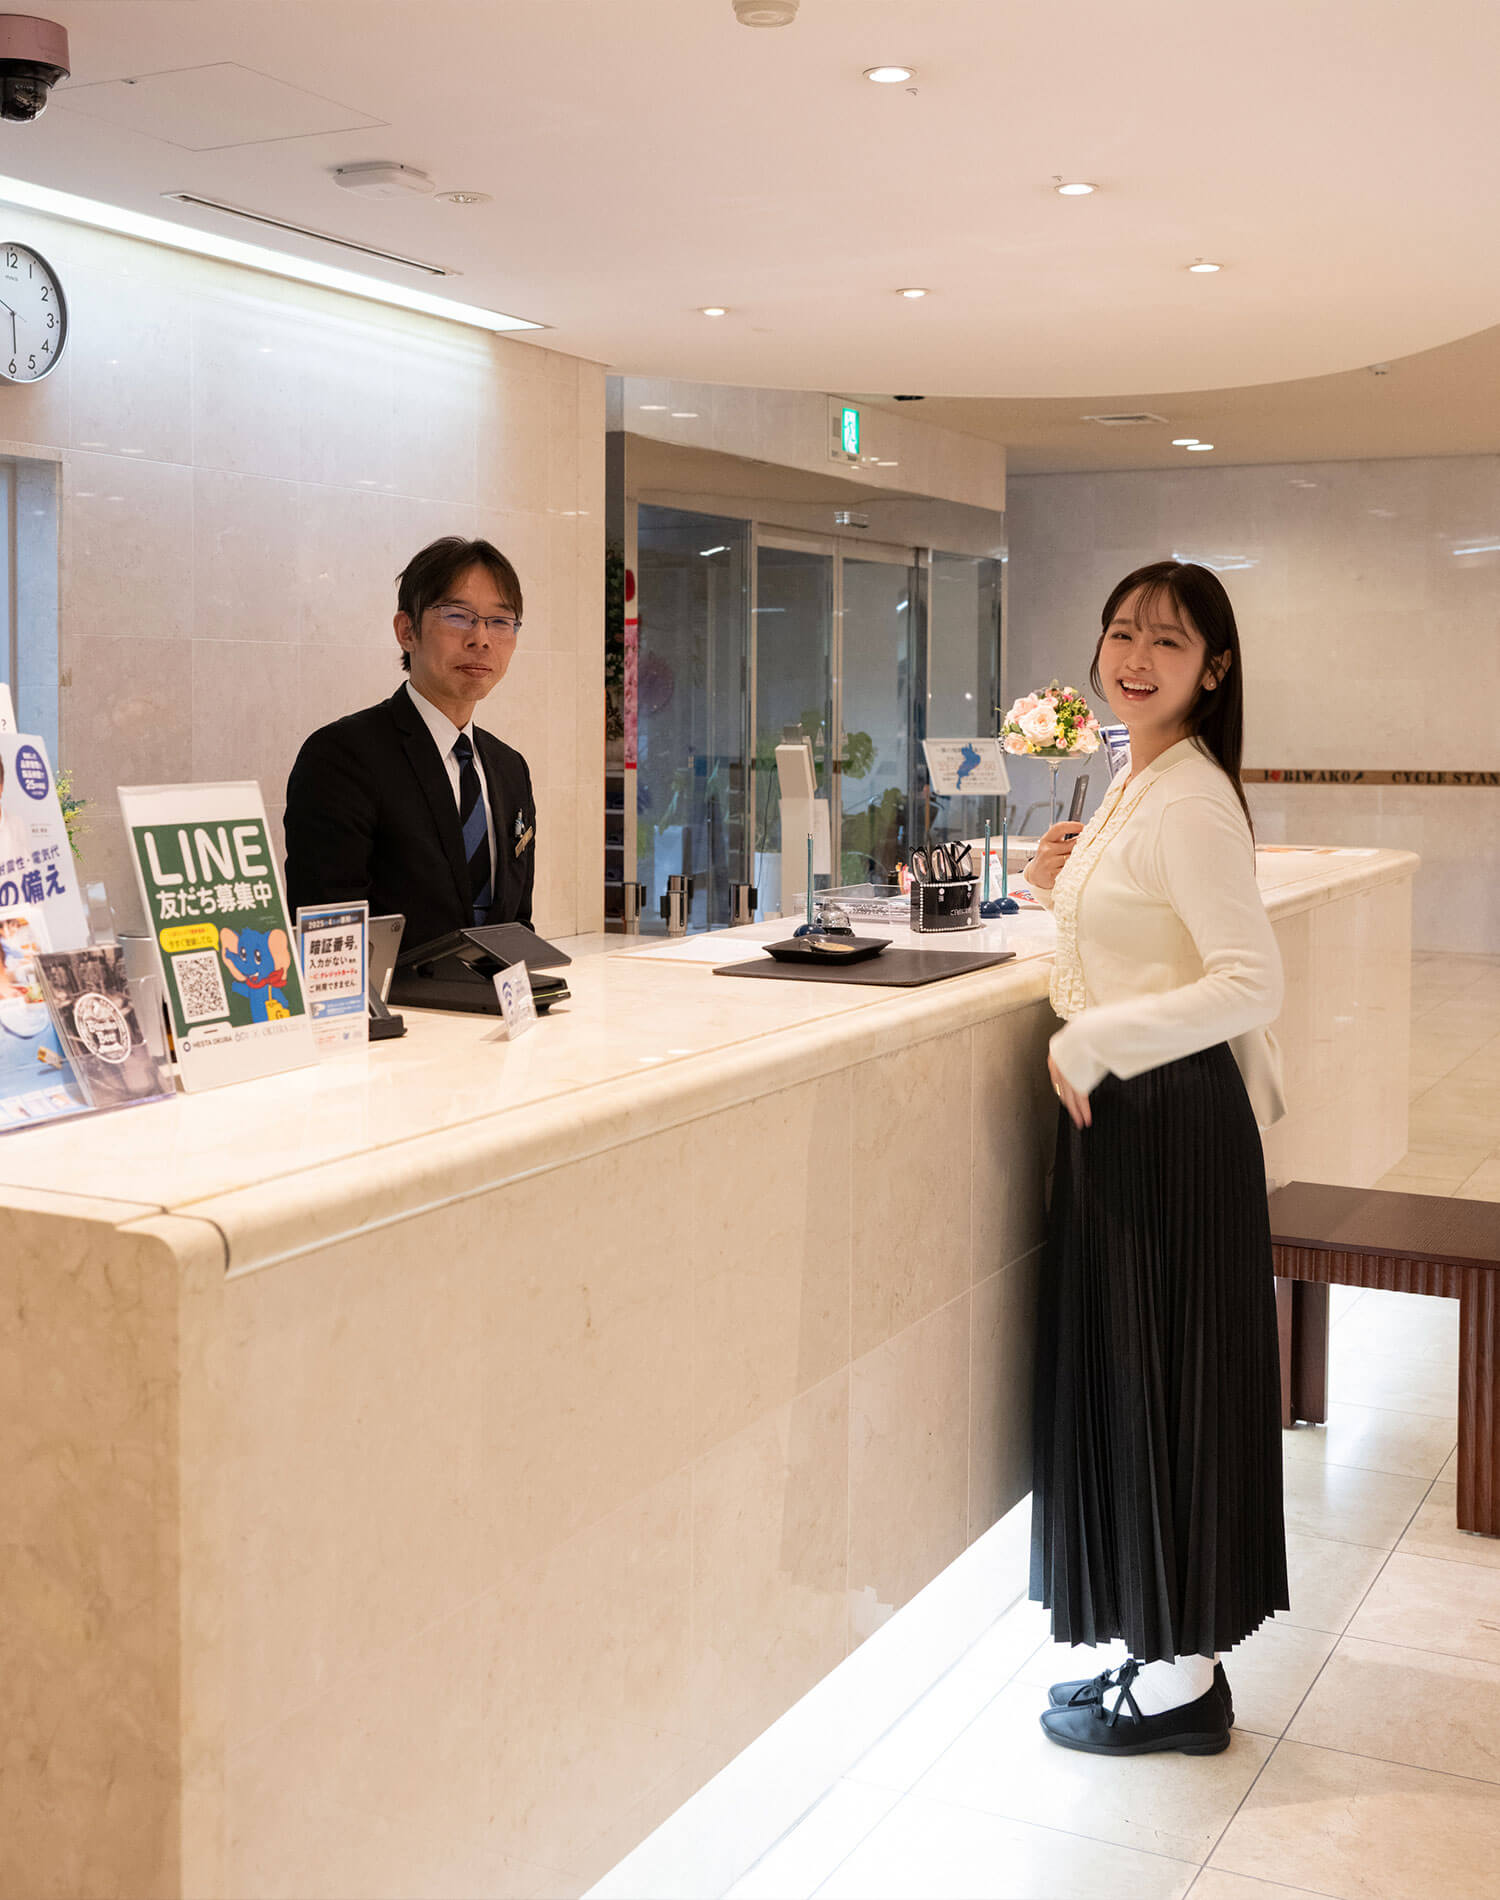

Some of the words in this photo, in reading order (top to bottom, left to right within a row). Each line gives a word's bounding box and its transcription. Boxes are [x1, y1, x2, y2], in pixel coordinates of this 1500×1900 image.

[7, 252, 18, 269] 12
[41, 286, 49, 302] 2
[46, 313, 55, 329] 3
[41, 339, 50, 353] 4
[8, 358, 17, 374] 6
[27, 354, 36, 370] 5
[1283, 770, 1351, 783] BIWAKO
[1392, 771, 1447, 784] CYCLE
[144, 825, 268, 886] LINE
[156, 880, 272, 919] 友だち募集中
